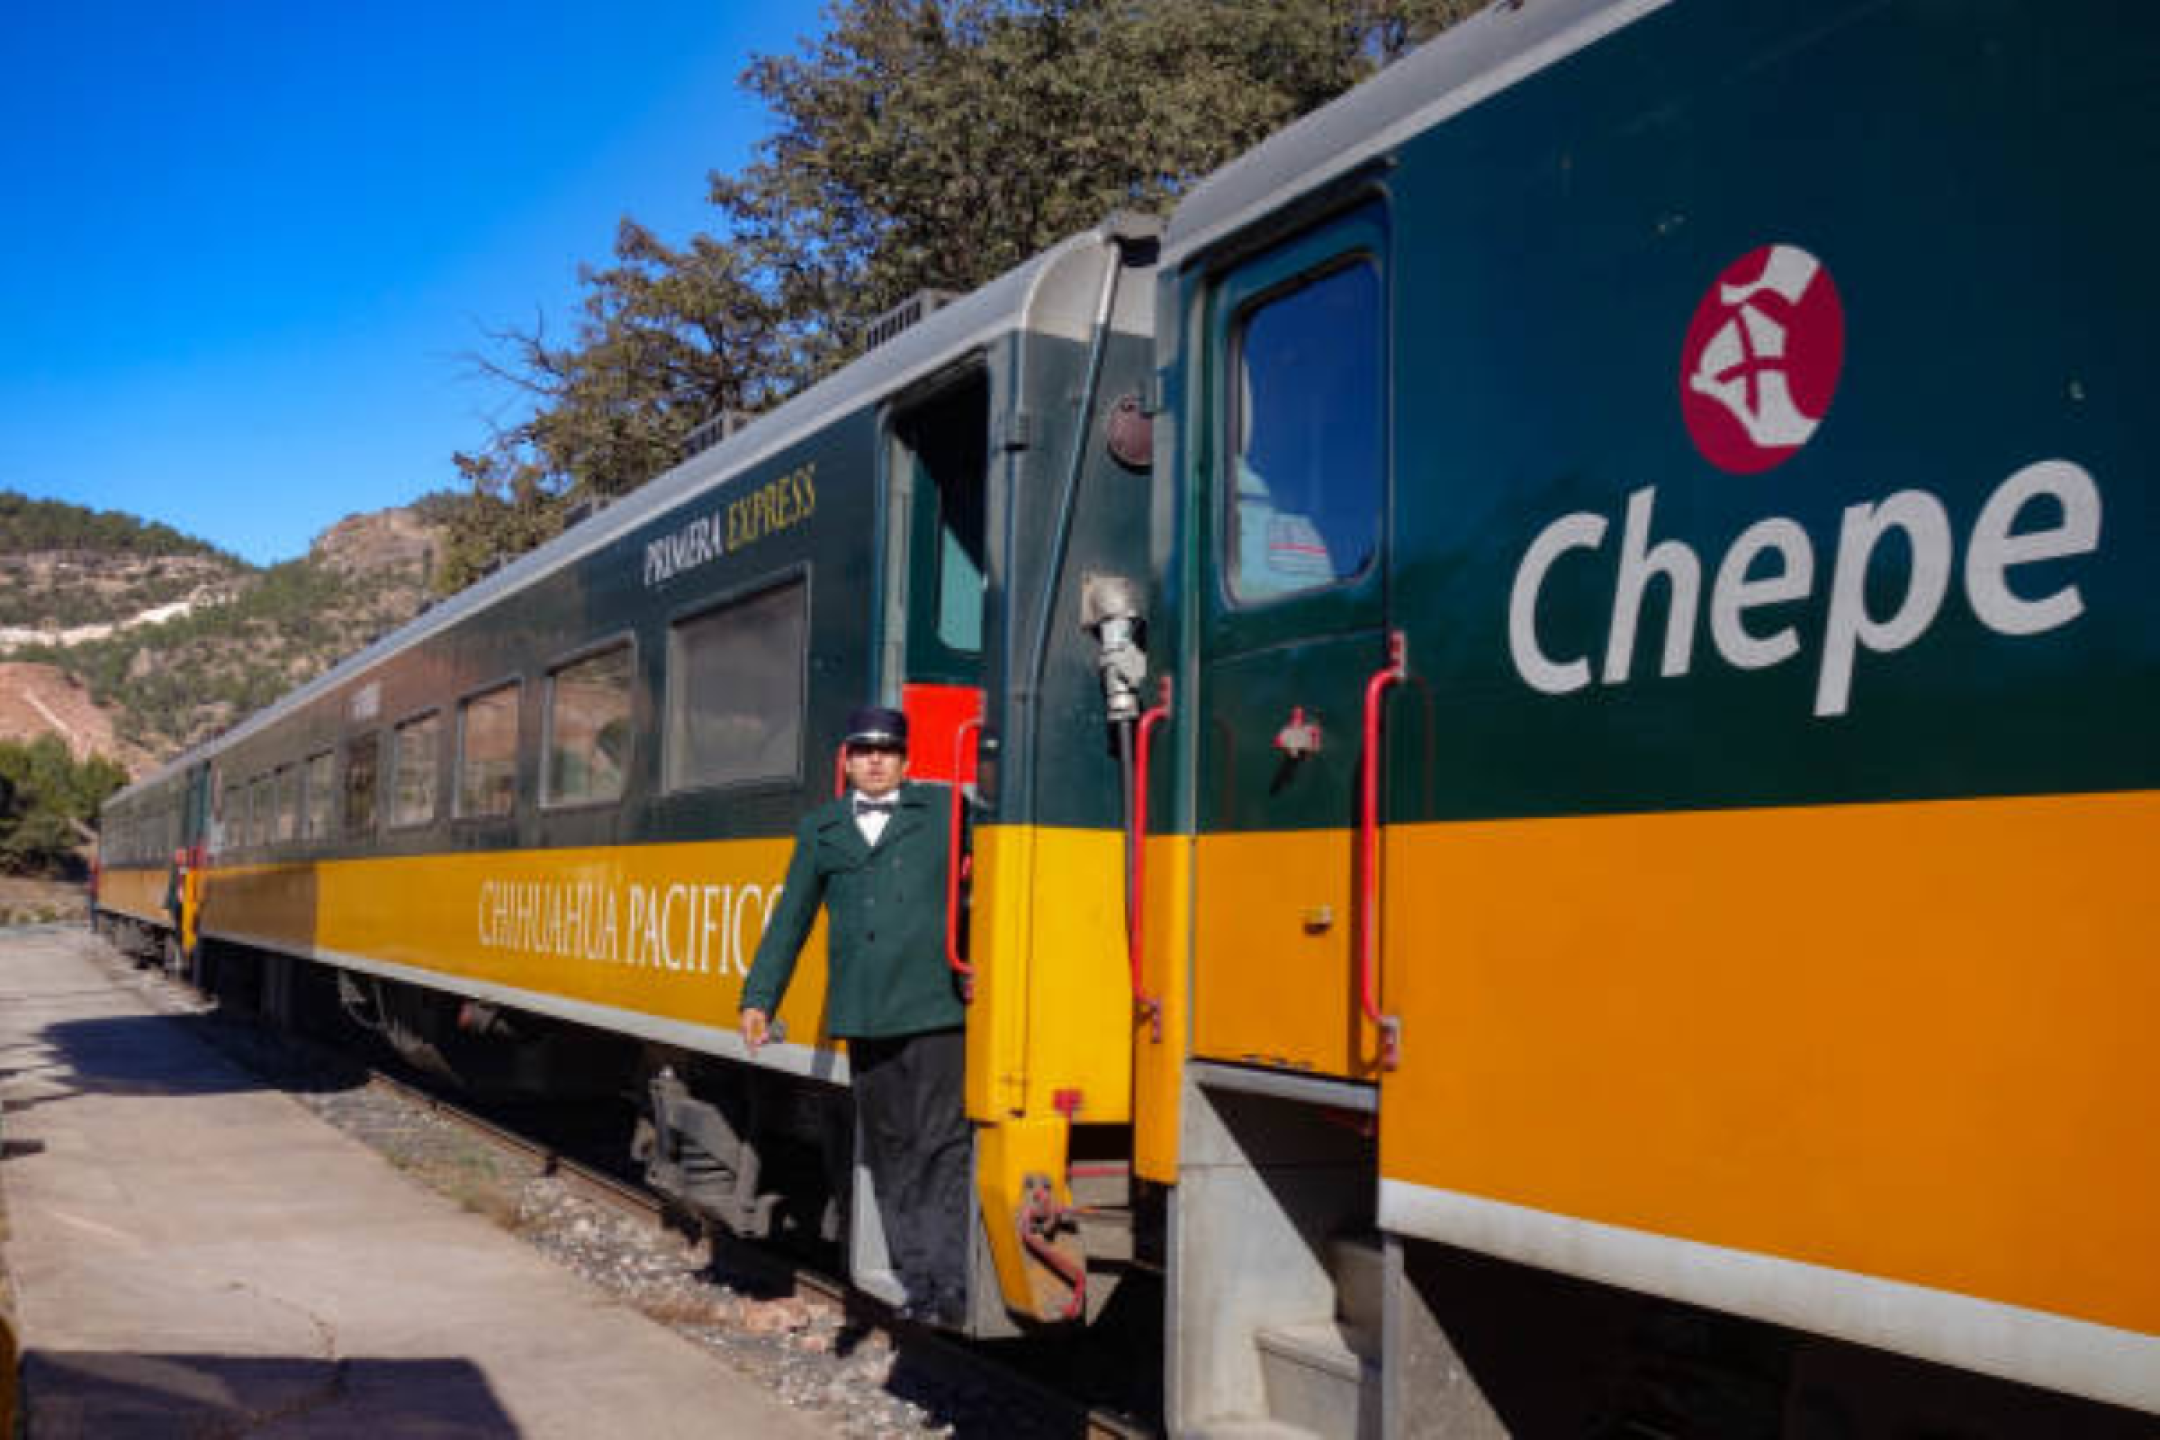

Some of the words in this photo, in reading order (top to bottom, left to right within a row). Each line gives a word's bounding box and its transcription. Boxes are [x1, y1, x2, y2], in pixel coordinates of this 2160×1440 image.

[727, 463, 817, 552] EXPRESS
[1508, 458, 2103, 717] Chepe
[477, 879, 619, 961] CHIHUAHUA
